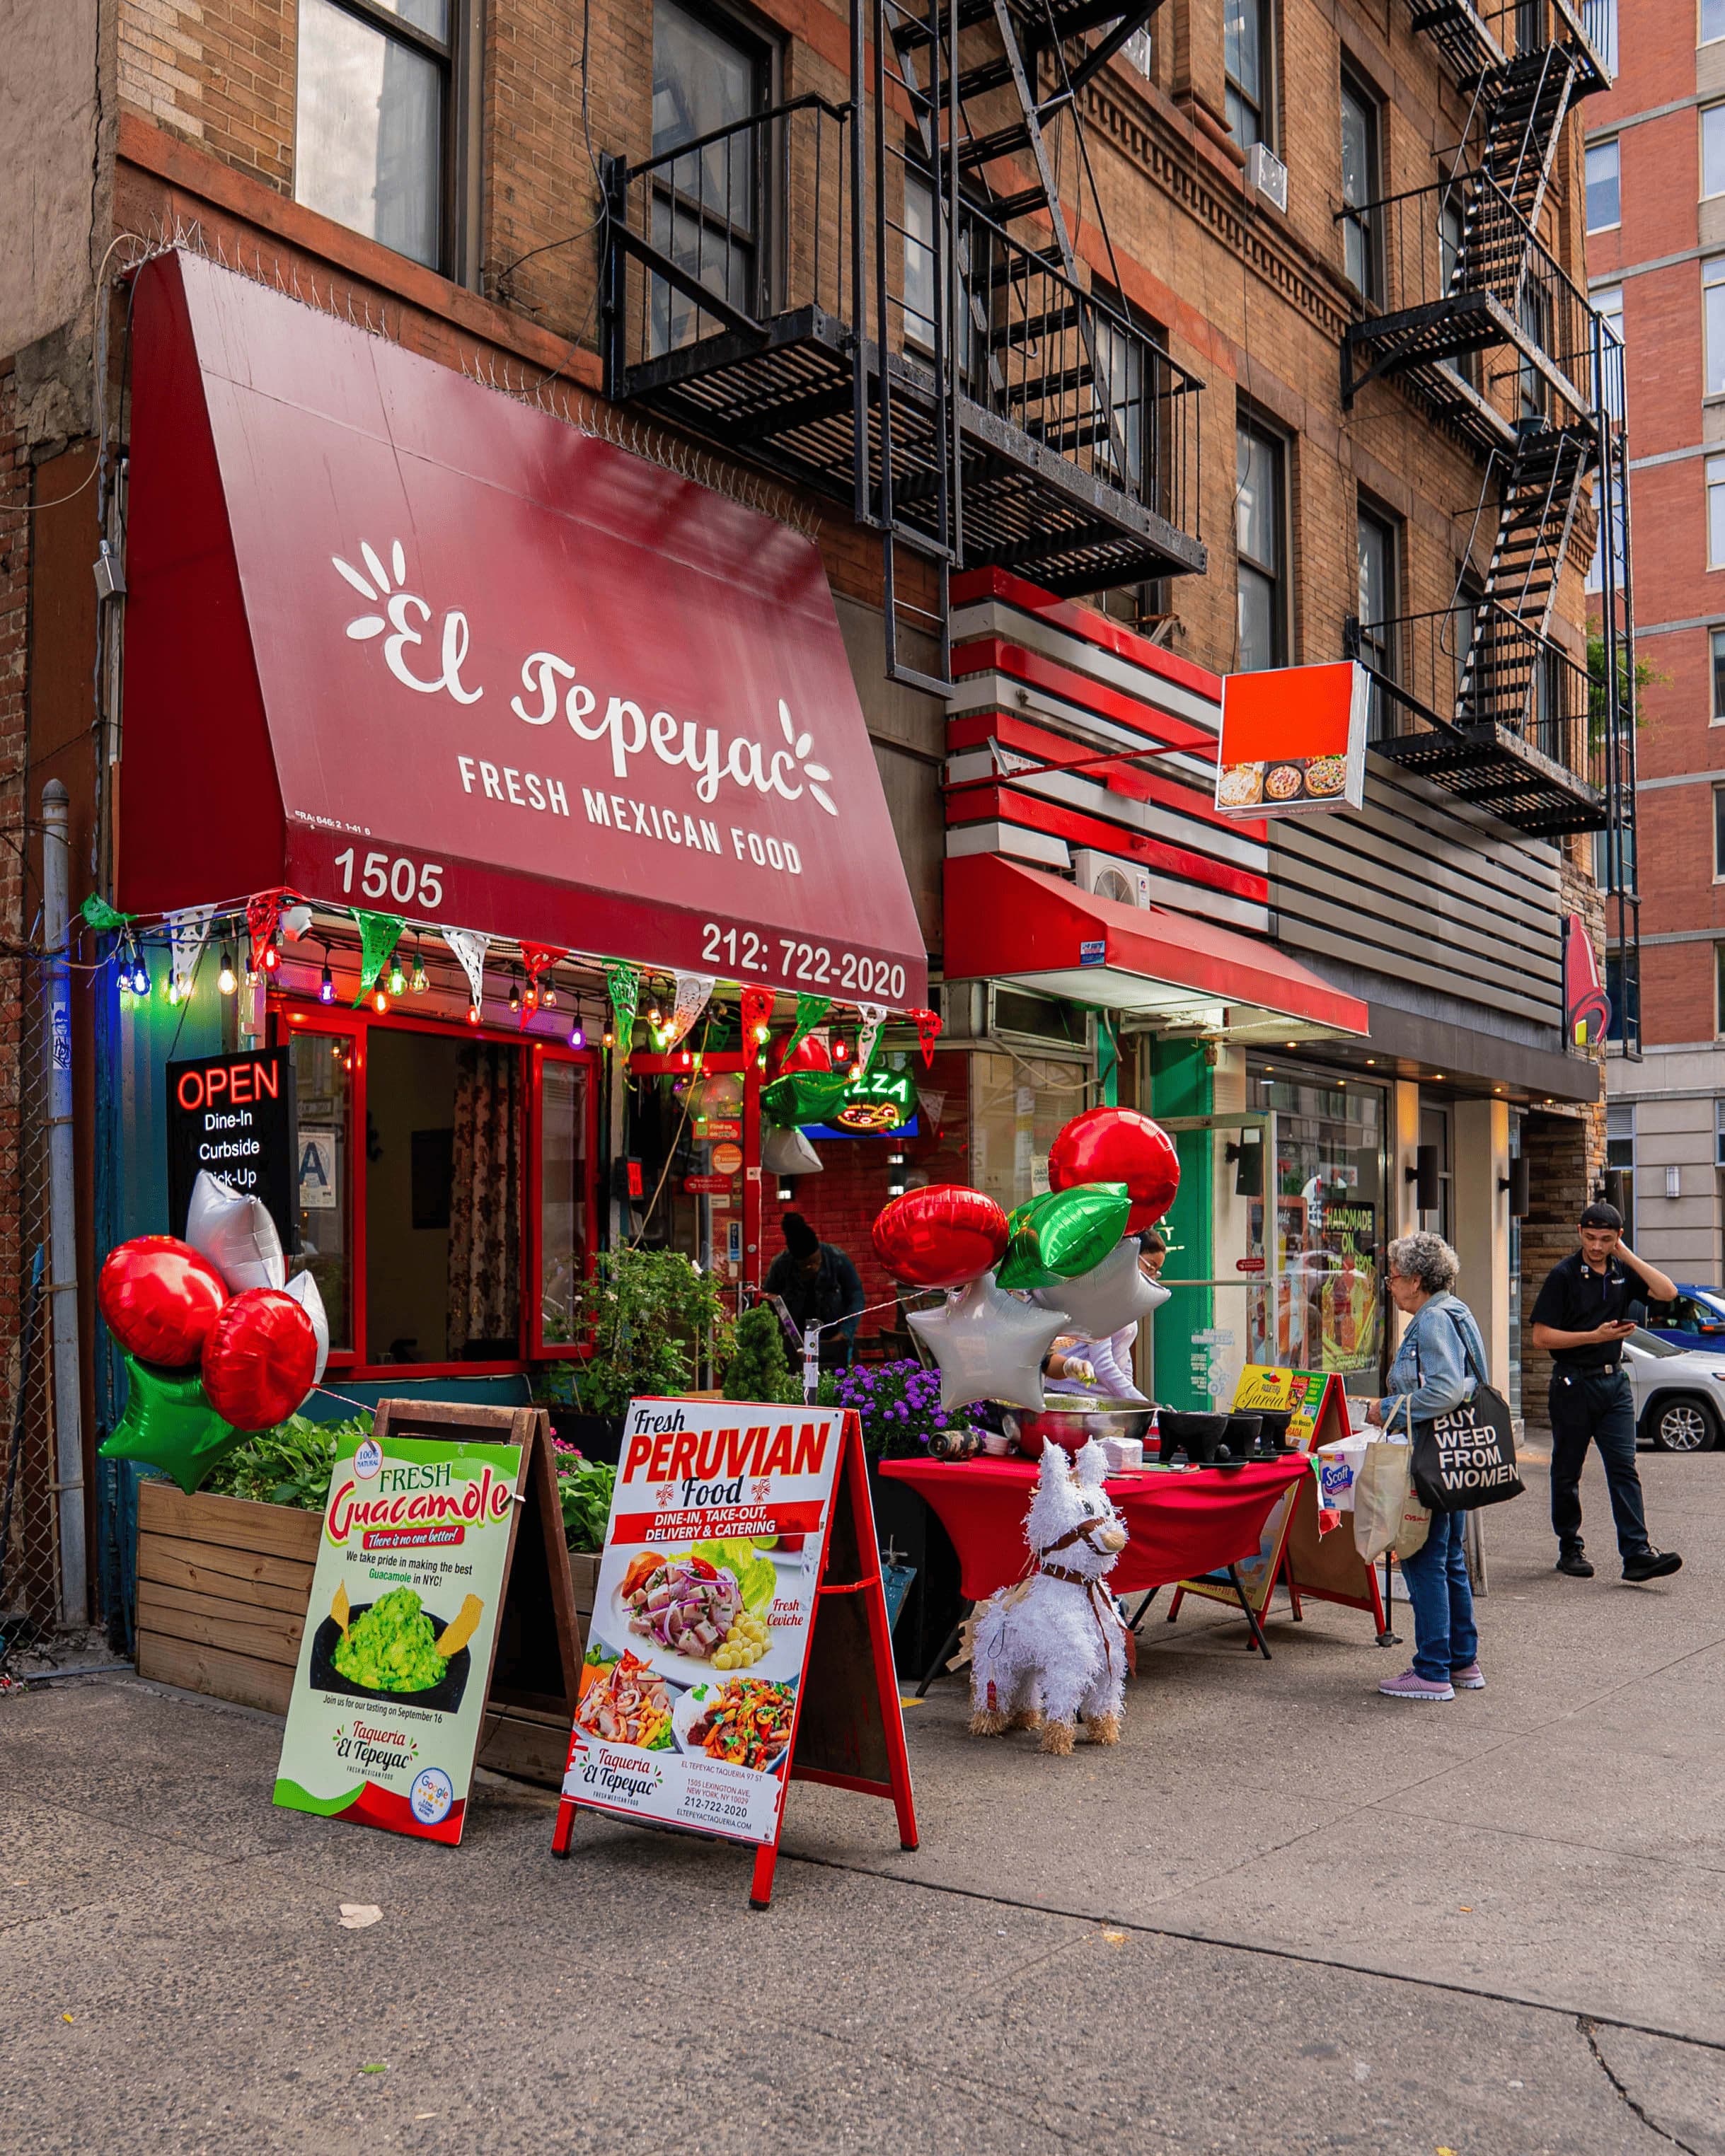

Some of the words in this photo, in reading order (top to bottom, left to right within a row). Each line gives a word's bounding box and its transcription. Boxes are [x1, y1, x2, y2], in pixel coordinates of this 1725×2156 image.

[383, 592, 485, 705] El
[511, 651, 804, 804] Tepeyac
[458, 756, 570, 817] FRESH
[582, 789, 721, 855] MEXICAN
[732, 828, 802, 875] FOOD
[335, 848, 444, 908] 1505
[702, 923, 768, 973] 212:
[780, 939, 906, 999] 722-2020
[178, 1060, 278, 1110] OPEN
[204, 1110, 253, 1131] Dine-In
[199, 1138, 260, 1160] Curbside
[299, 1142, 328, 1186] A
[213, 1168, 257, 1188] ick-Up
[1327, 1207, 1373, 1231] HANDMADE
[1342, 1231, 1354, 1255] ON
[634, 1408, 685, 1435] Fresh
[1433, 1408, 1475, 1431] BUY
[1433, 1425, 1496, 1449] WEED
[622, 1422, 831, 1484] PERUVIAN
[1438, 1445, 1502, 1469] FROM
[379, 1464, 451, 1493] FRESH
[1326, 1466, 1349, 1486] Scott
[1441, 1464, 1519, 1490] WOMEN
[681, 1475, 744, 1507] Food
[328, 1468, 508, 1540] Guacamole
[654, 1511, 703, 1526] DINE-IN,
[705, 1506, 768, 1522] TAKE-OUT,
[369, 1533, 391, 1548] There
[393, 1534, 400, 1546] is
[400, 1536, 410, 1546] no
[412, 1535, 427, 1544] one
[428, 1527, 459, 1543] better!
[645, 1526, 702, 1541] DELIVERY
[702, 1525, 711, 1537] &
[715, 1520, 776, 1536] CATERING
[346, 1551, 357, 1561] We
[359, 1552, 376, 1564] take
[377, 1555, 398, 1566] pride
[399, 1557, 407, 1567] in
[408, 1559, 438, 1573] making
[440, 1562, 452, 1572] the
[454, 1563, 473, 1575] best
[369, 1568, 412, 1583] Guacamole
[413, 1573, 420, 1584] in
[422, 1575, 442, 1587] NYC!
[773, 1599, 800, 1611] Fresh
[767, 1611, 804, 1626] Ceviche
[323, 1694, 336, 1705] Join
[345, 1698, 354, 1708] for
[354, 1701, 366, 1710] our
[366, 1702, 388, 1717] tasting
[398, 1707, 433, 1723] September
[434, 1714, 442, 1724] 16
[338, 1738, 352, 1758] El
[354, 1741, 410, 1772] Tepeyac
[362, 1767, 381, 1778] MEXICAN
[584, 1764, 598, 1783] El
[600, 1768, 654, 1797] Tepeyac
[689, 1761, 715, 1773] TEPEYAC
[716, 1767, 745, 1780] TAQUERIA
[746, 1773, 754, 1781] 97
[422, 1775, 449, 1799] Google
[686, 1787, 701, 1795] NEW
[731, 1795, 749, 1805] 10029
[688, 1778, 701, 1787] 1505
[702, 1781, 737, 1795] LEXINGTON
[684, 1796, 747, 1818] 212-722-2020
[676, 1808, 752, 1831] ELTEPEYACTAQUERIA.COM
